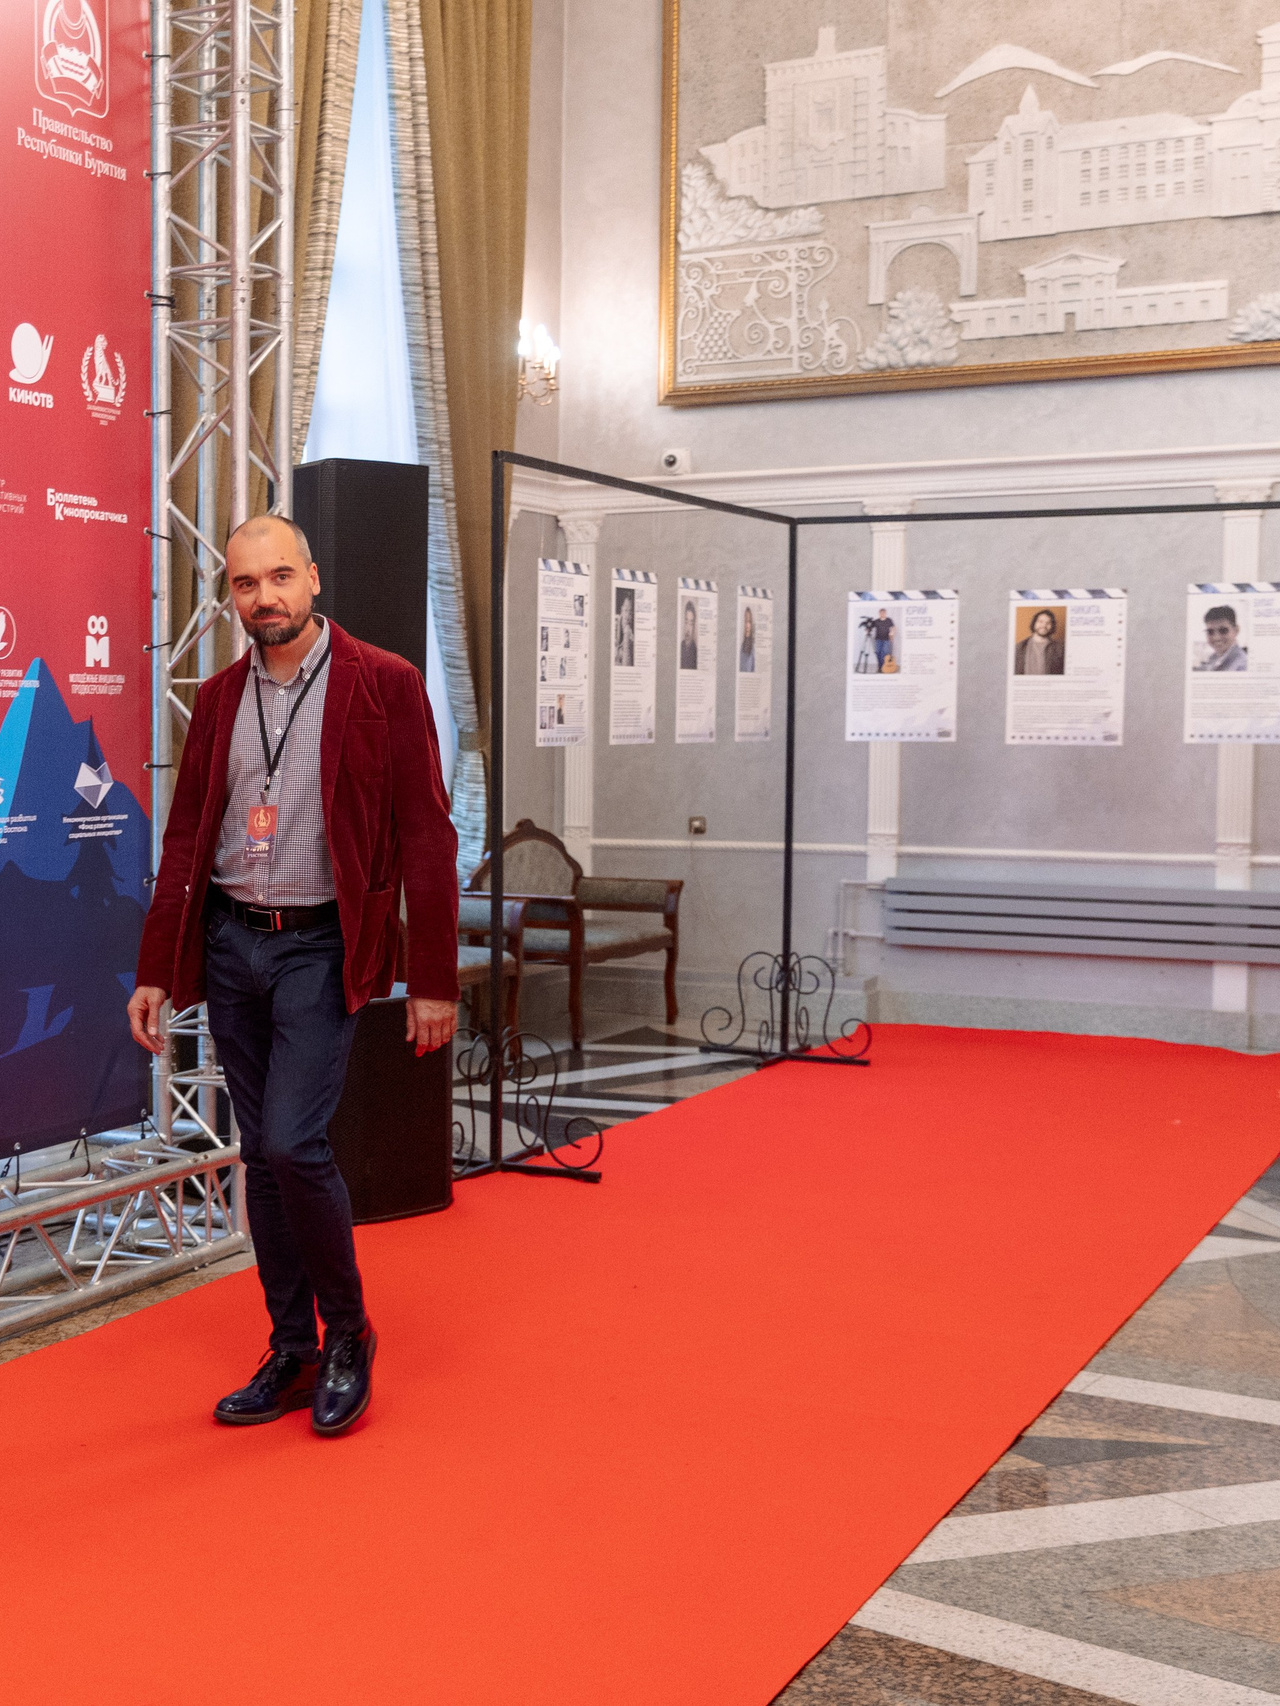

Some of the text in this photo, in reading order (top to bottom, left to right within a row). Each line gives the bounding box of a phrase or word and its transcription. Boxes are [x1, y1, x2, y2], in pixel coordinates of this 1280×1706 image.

[32, 107, 113, 152] Правительство
[17, 127, 127, 181] Республики Бурятия
[9, 387, 54, 408] КИНОТВ
[47, 487, 98, 507] Бюллетень
[55, 503, 128, 524] Кинопрокатчика
